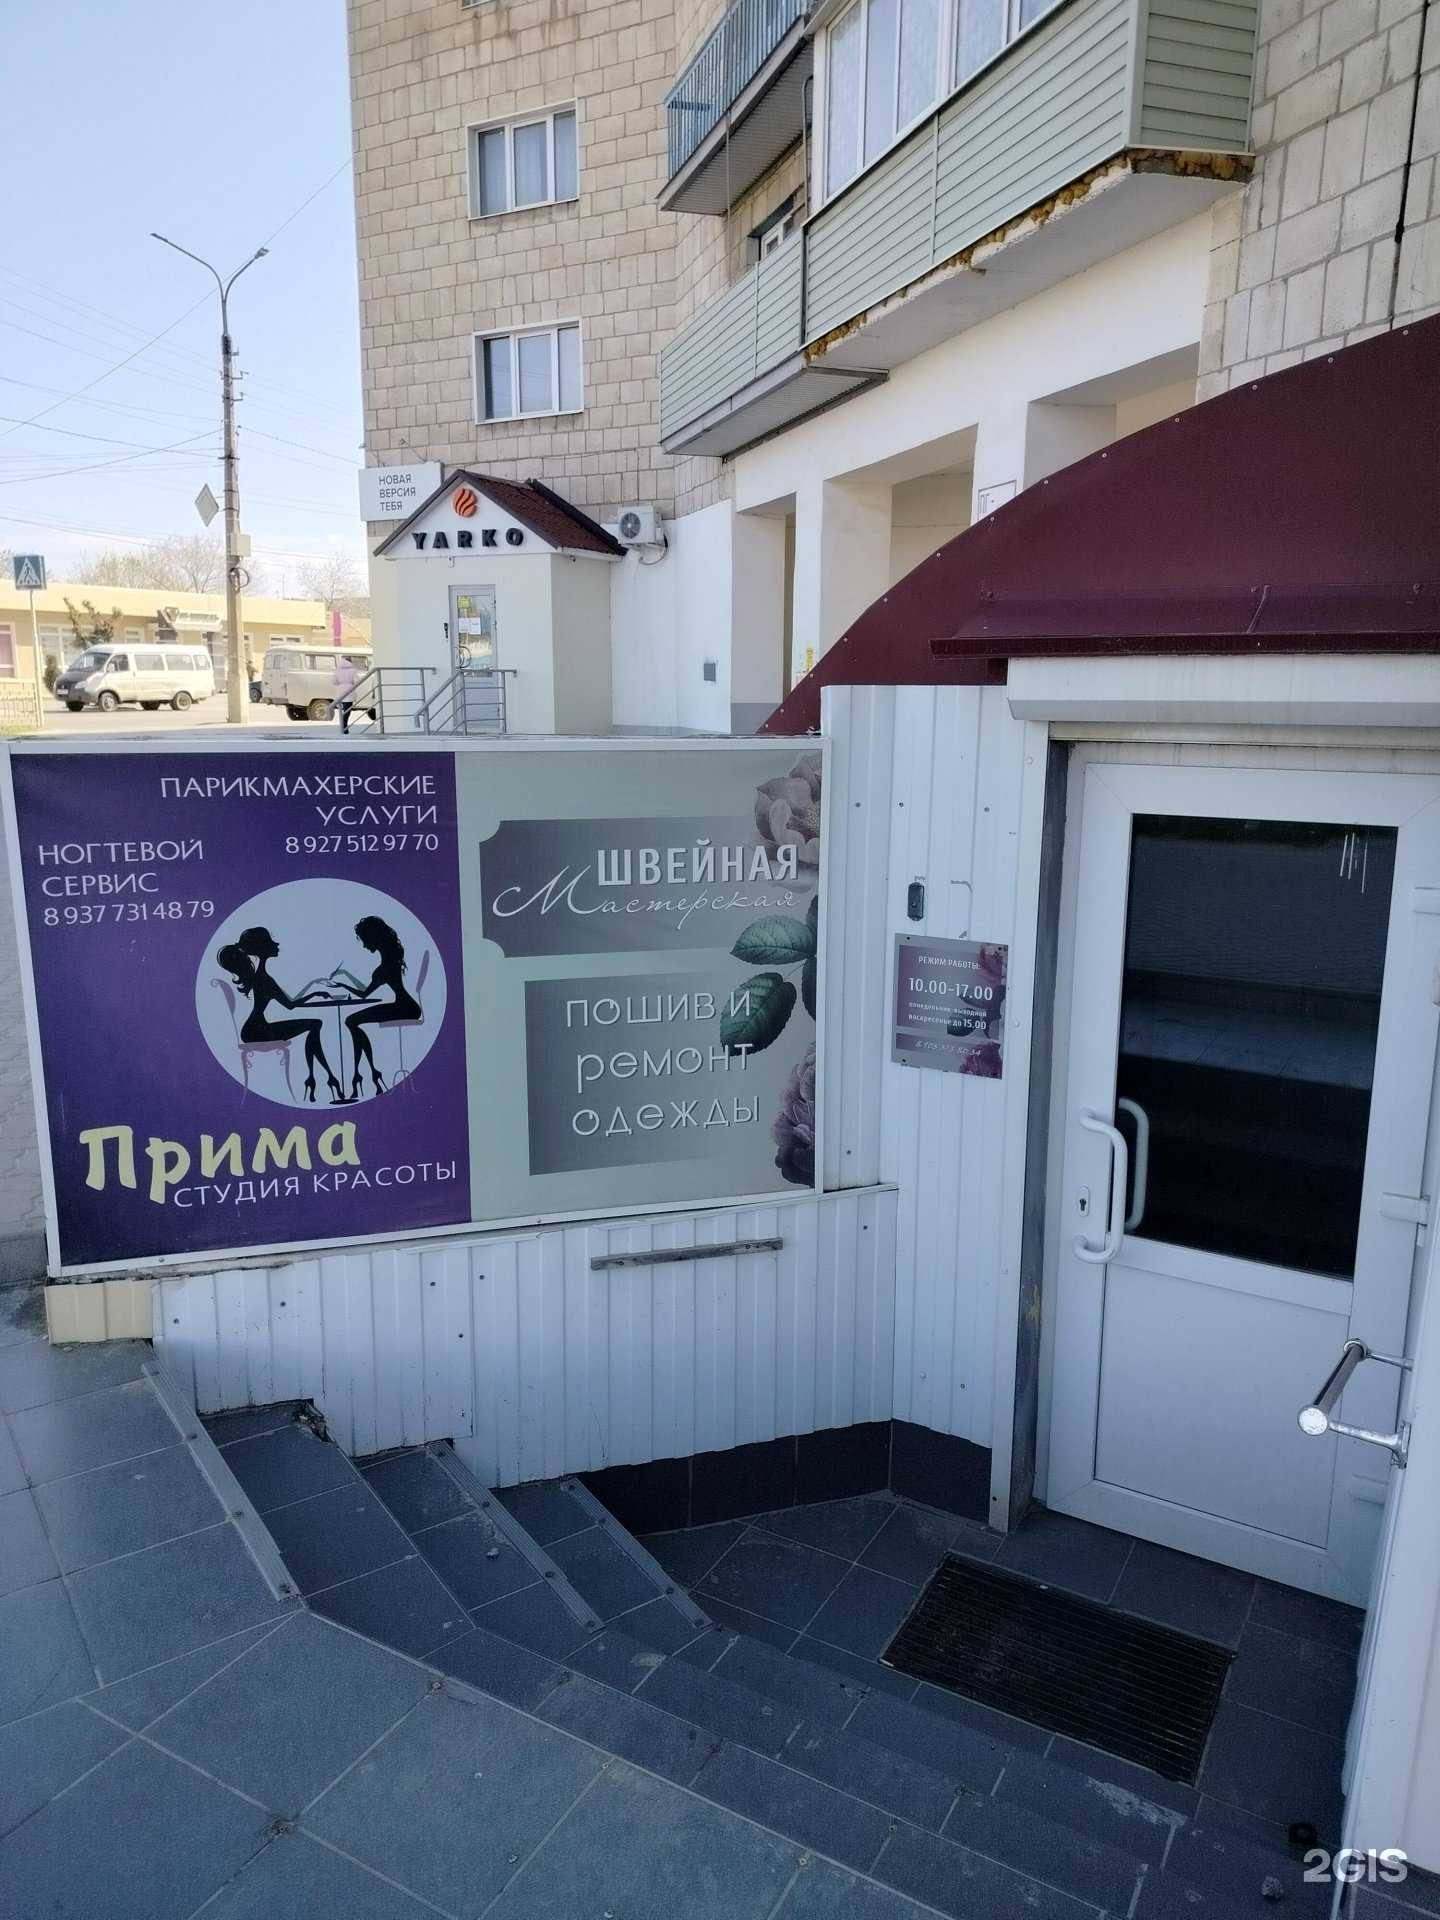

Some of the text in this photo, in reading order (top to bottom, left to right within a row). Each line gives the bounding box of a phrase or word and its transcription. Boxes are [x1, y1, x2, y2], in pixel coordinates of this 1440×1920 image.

[378, 474, 412, 486] НОВАЯ
[379, 488, 416, 499] ВЕРСИЯ
[380, 501, 403, 512] ТЕБЯ
[412, 527, 524, 550] YARKO
[160, 775, 436, 798] ПАРИКМАХЕРСКИЕ
[316, 805, 437, 826] УСЛУГИ
[38, 839, 204, 866] НОГТЕВОЙ
[285, 833, 439, 854] 8 927 512 97 70
[597, 838, 799, 886] ШВЕЙНАЯ
[42, 872, 159, 897] СЕРВИС
[492, 864, 797, 930] Мастерская
[44, 900, 215, 926] 8 937 731 48 79
[908, 977, 993, 1001] 10.00-17.00
[79, 1120, 361, 1204] Прима
[173, 1160, 457, 1209] СТУДИЯ КРАСОТЫ
